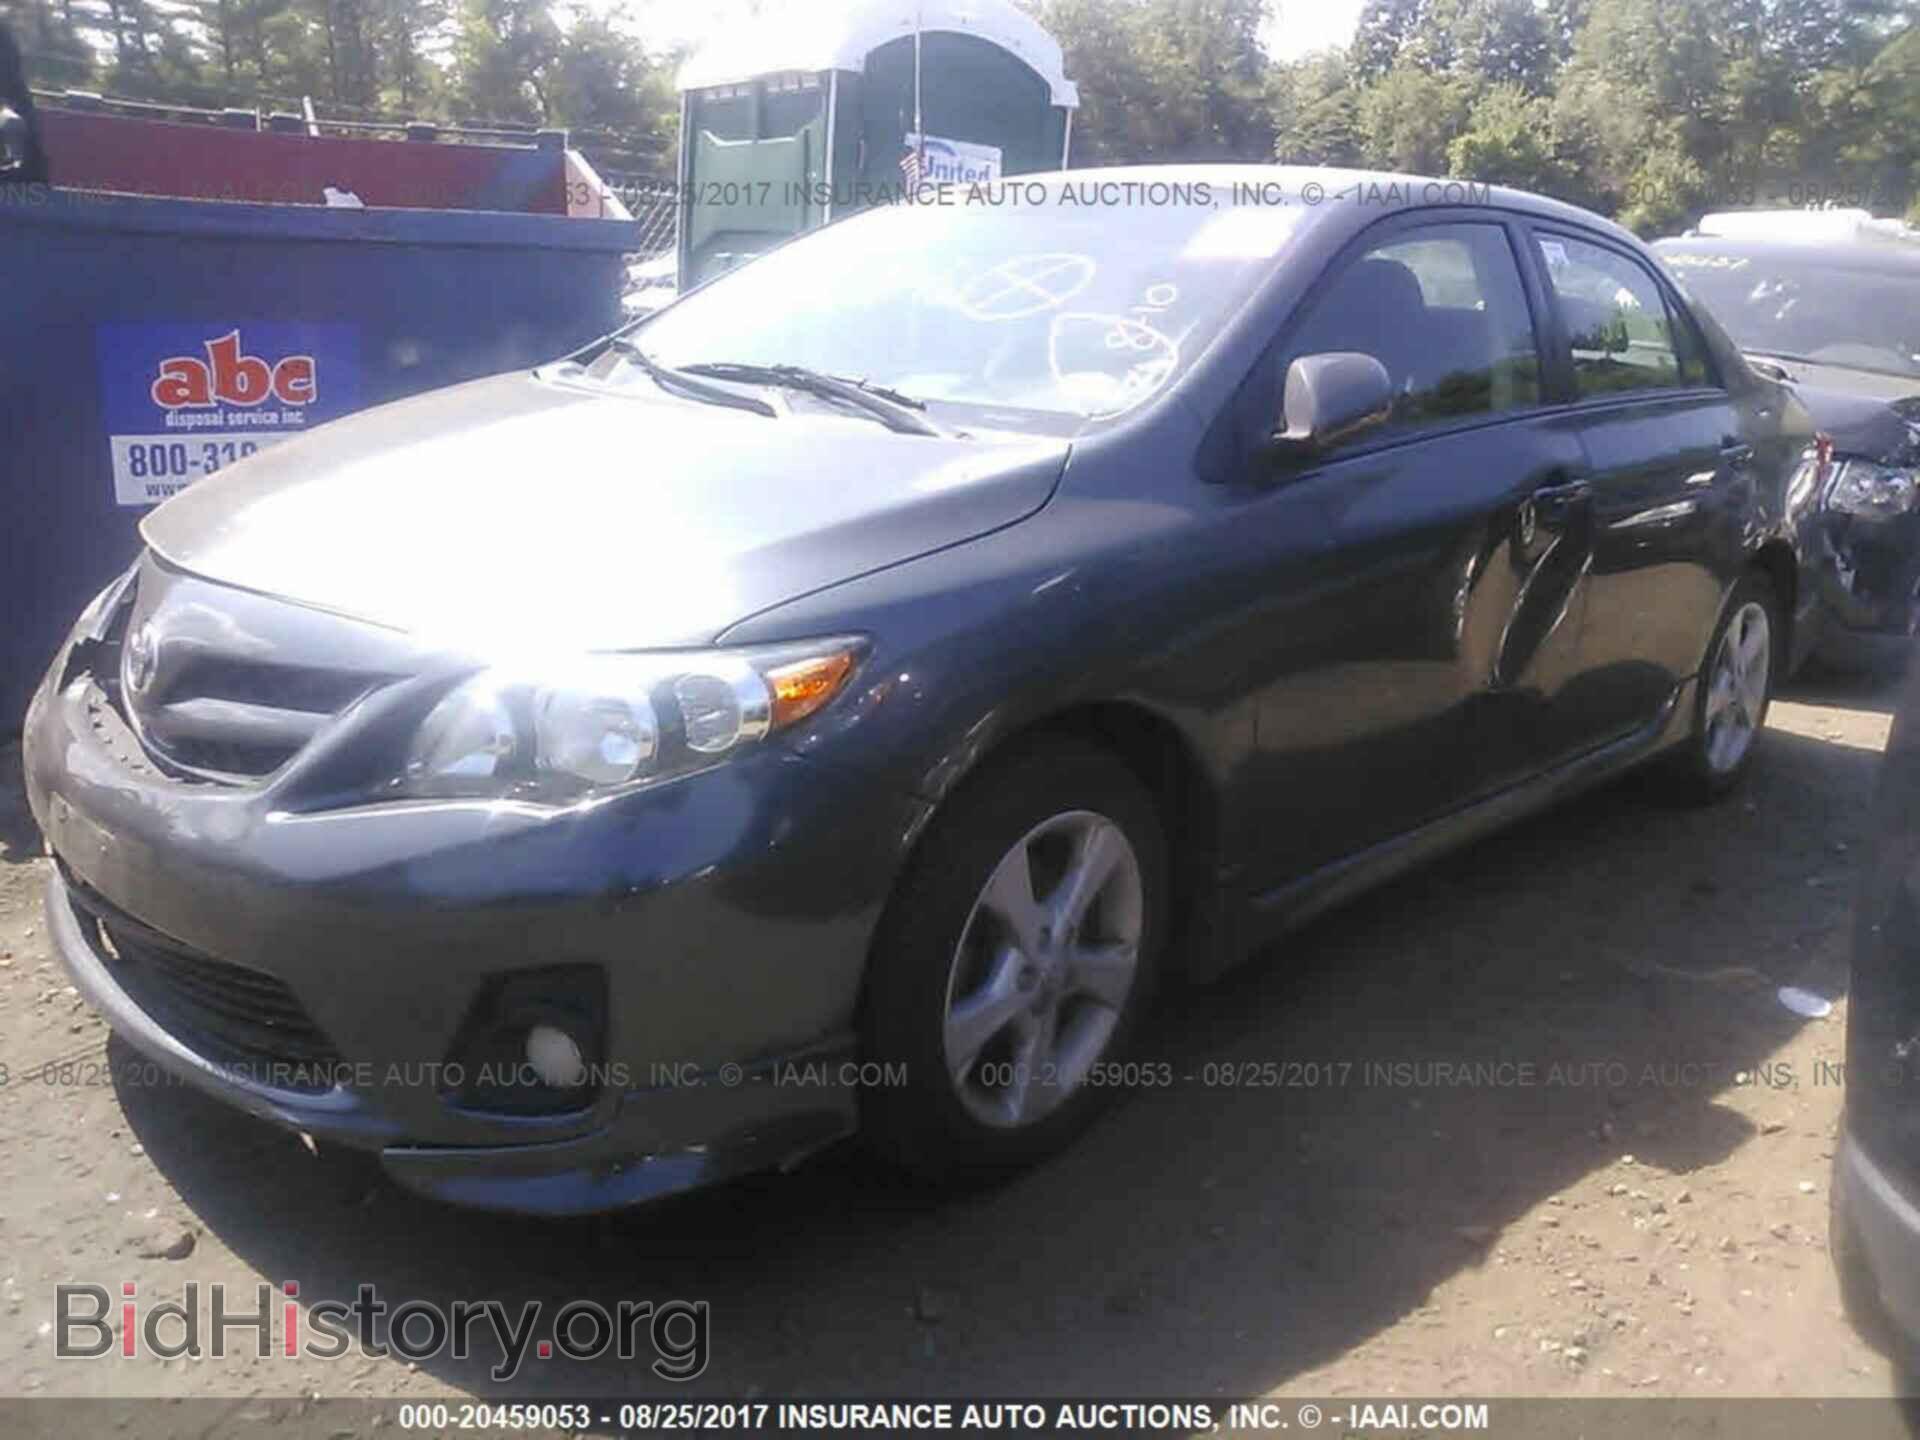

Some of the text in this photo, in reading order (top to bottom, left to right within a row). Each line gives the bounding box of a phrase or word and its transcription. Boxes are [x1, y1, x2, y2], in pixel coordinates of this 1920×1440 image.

[151, 329, 317, 409] abc
[166, 409, 224, 431] disposal
[227, 408, 279, 426] service
